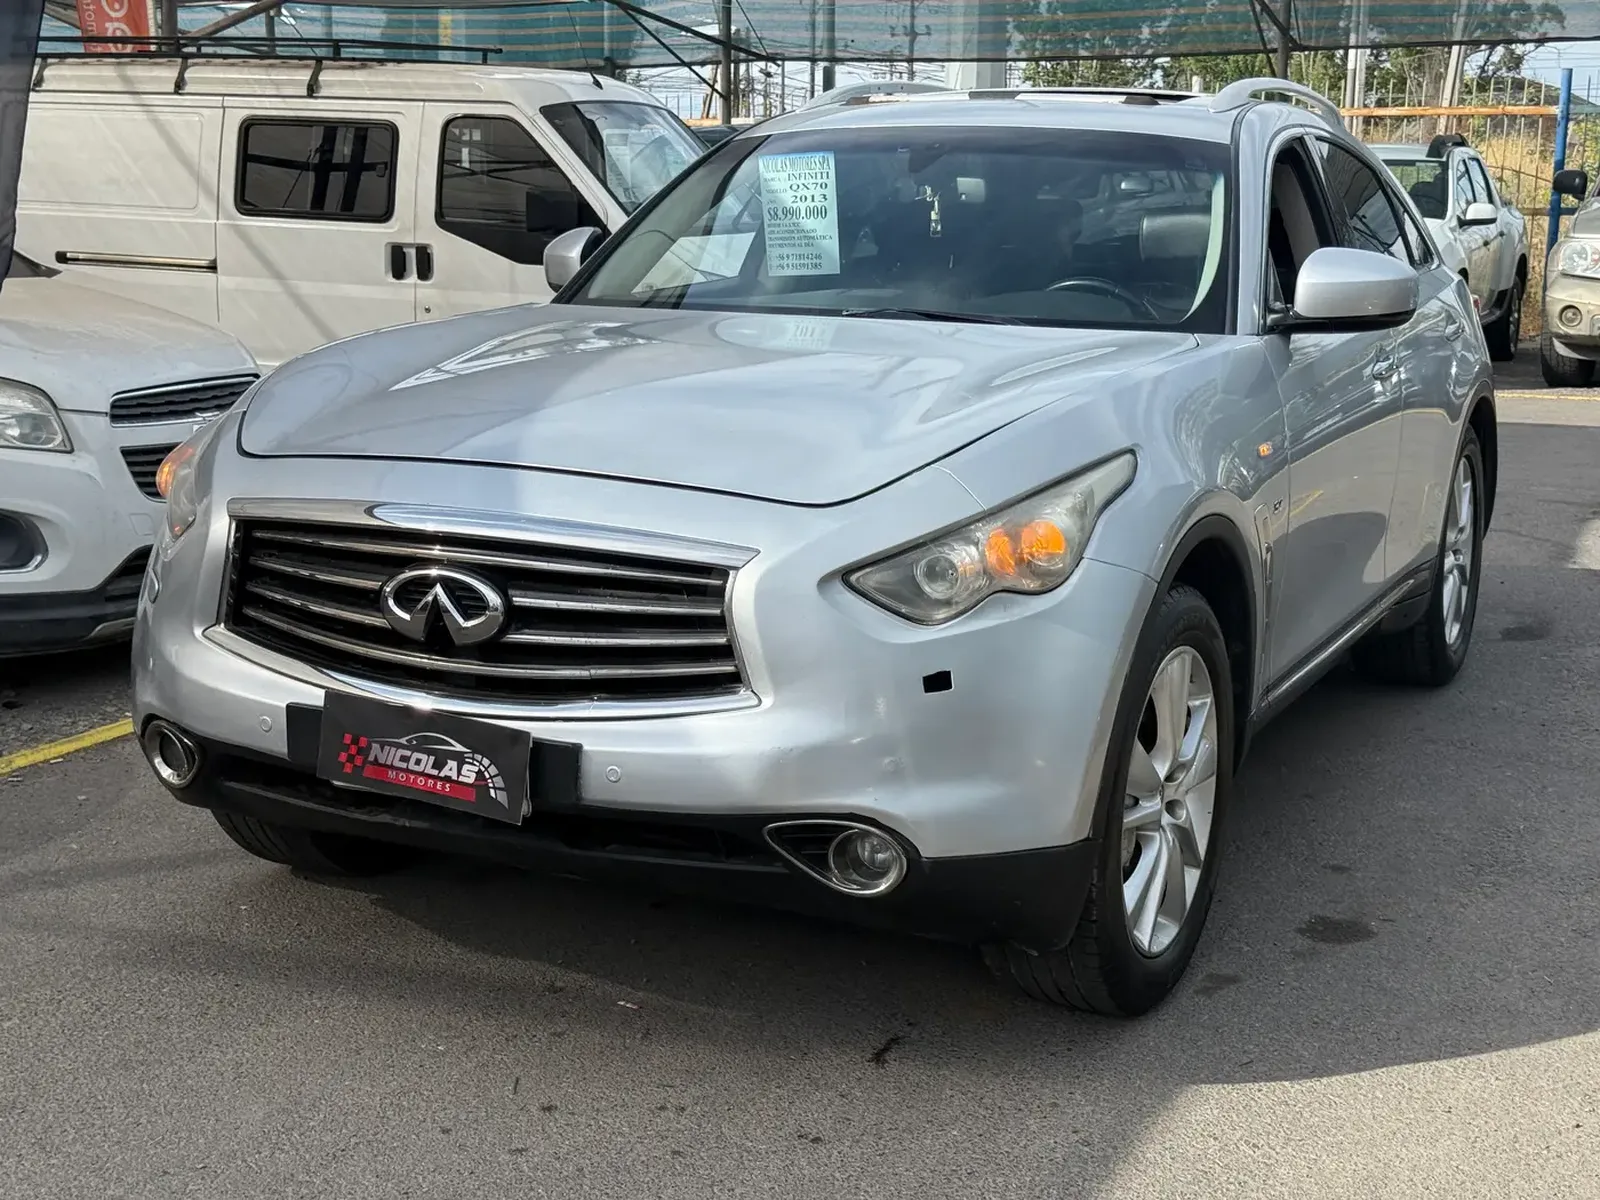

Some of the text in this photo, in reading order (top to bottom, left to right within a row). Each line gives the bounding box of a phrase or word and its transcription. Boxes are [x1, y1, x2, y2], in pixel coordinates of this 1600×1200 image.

[762, 155, 831, 173] NICOLAS MOTORES SPA
[788, 171, 830, 181] INFINITI
[789, 182, 828, 192] QX70
[790, 194, 828, 204] 2013
[767, 205, 828, 221] $8.990.000
[368, 743, 479, 784] NICOLAS
[387, 770, 451, 792] MOTORES
